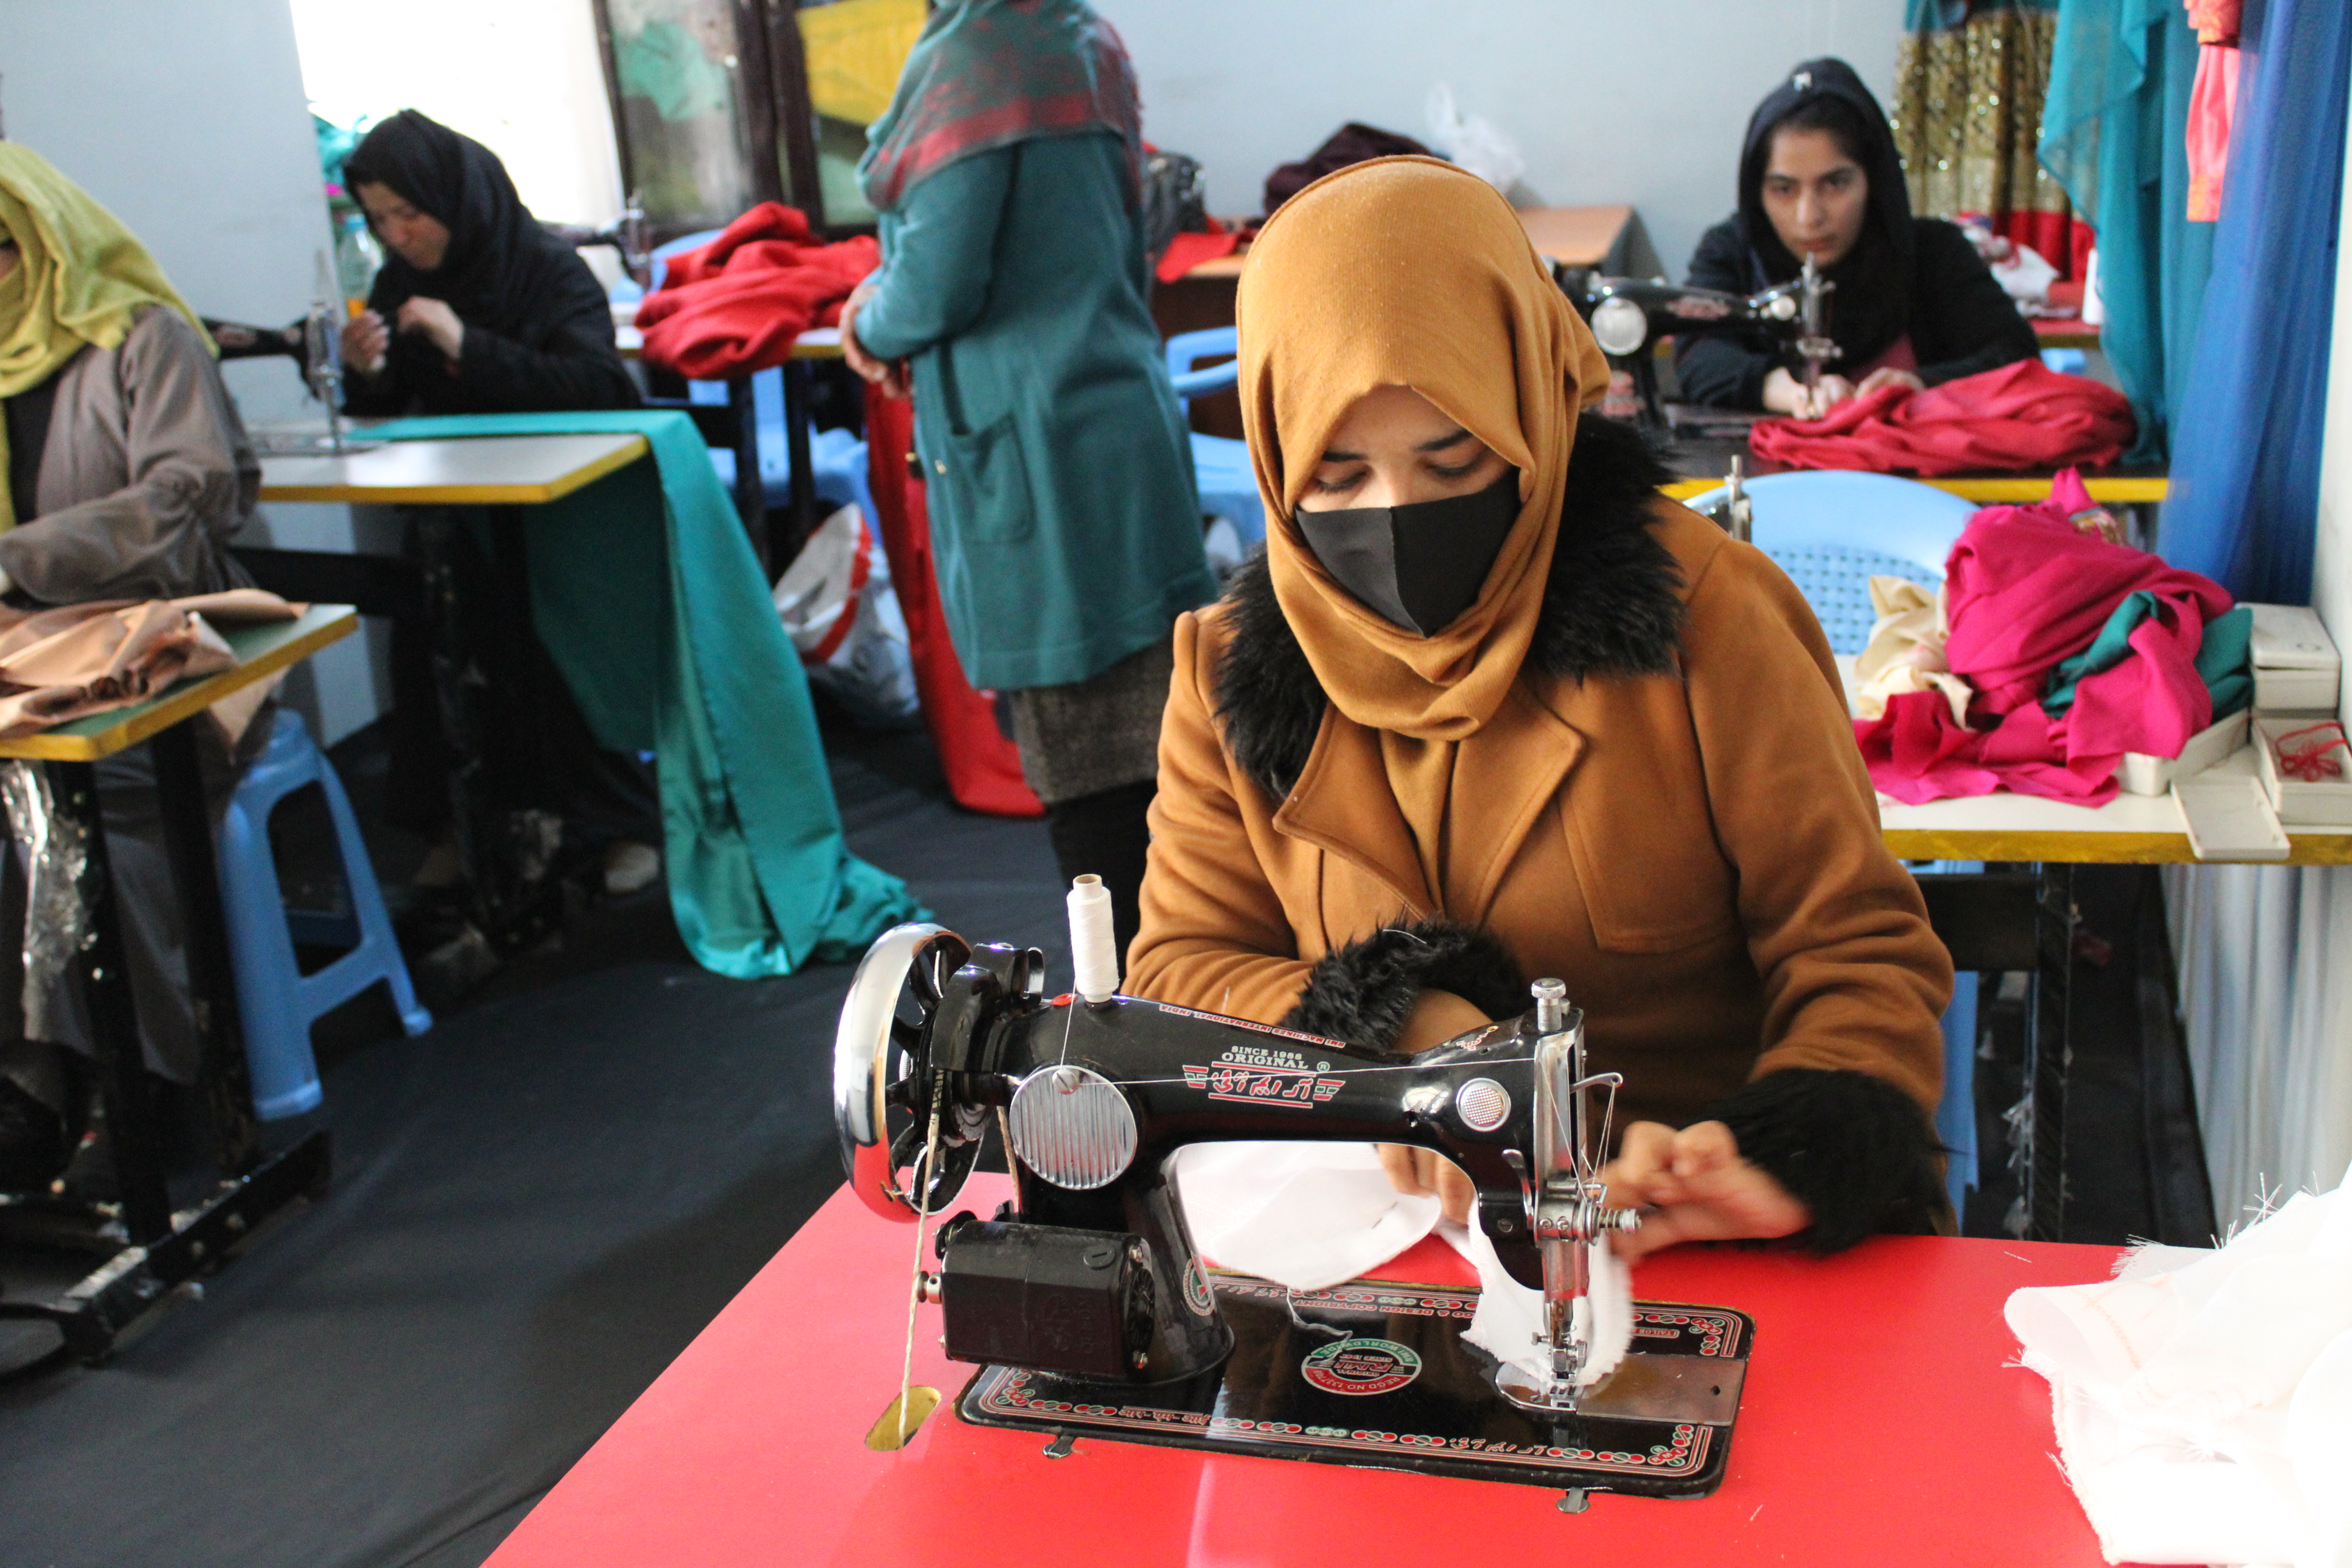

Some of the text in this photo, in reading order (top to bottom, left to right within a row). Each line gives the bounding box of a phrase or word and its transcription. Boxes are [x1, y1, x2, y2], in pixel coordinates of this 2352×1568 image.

[1159, 1004, 1345, 1048] RMI MACHINES INTERNATIONAL INDIA
[1231, 1045, 1269, 1056] SINCE
[1221, 1052, 1308, 1070] ORIGINAL
[1293, 1299, 1377, 1311] COPYRIGHT
[1379, 1305, 1434, 1316] DESIGN
[1452, 1310, 1475, 1318] GO
[1319, 1340, 1399, 1356] WORLDWDE
[1334, 1361, 1394, 1372] RMI
